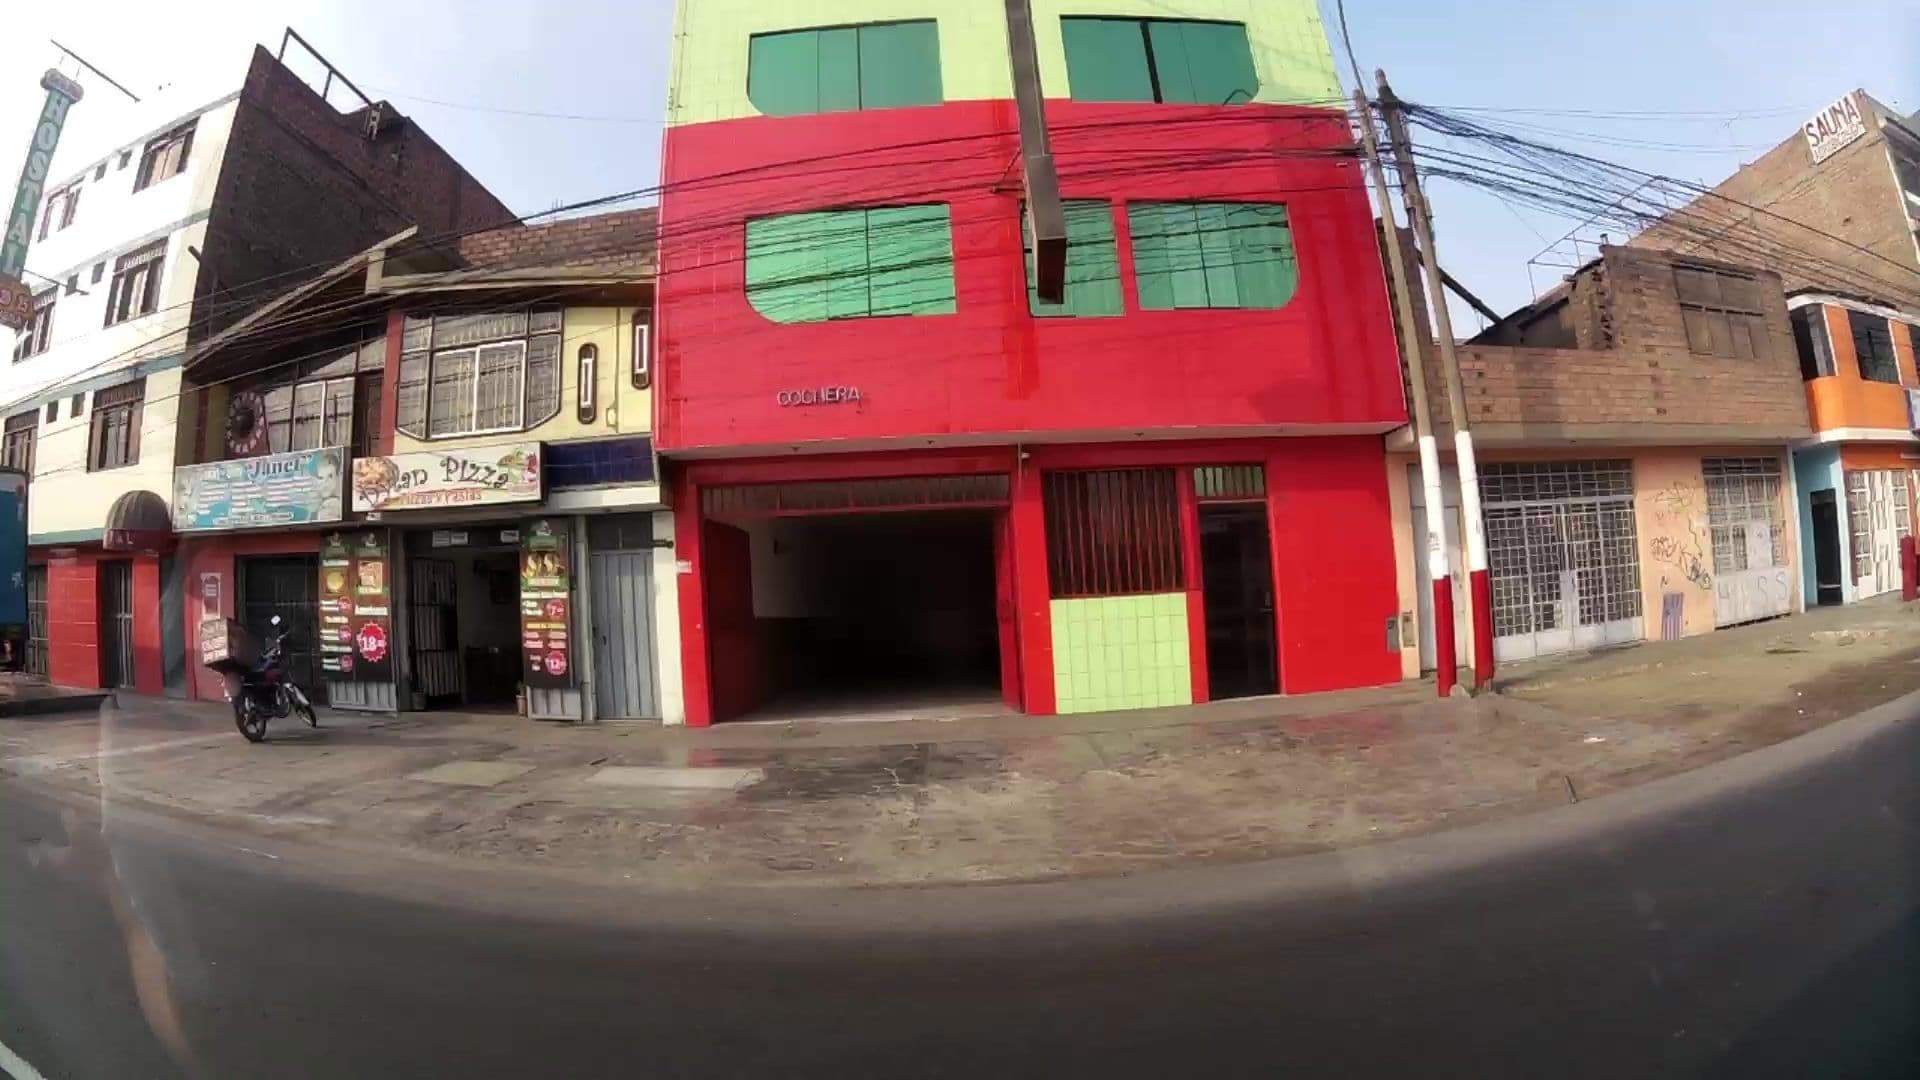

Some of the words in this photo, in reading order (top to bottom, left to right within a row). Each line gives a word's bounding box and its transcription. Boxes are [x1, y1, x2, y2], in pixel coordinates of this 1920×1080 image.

[1805, 96, 1859, 146] SAUNA
[3, 92, 70, 278] HOSTAL
[777, 386, 860, 405] COCHERA
